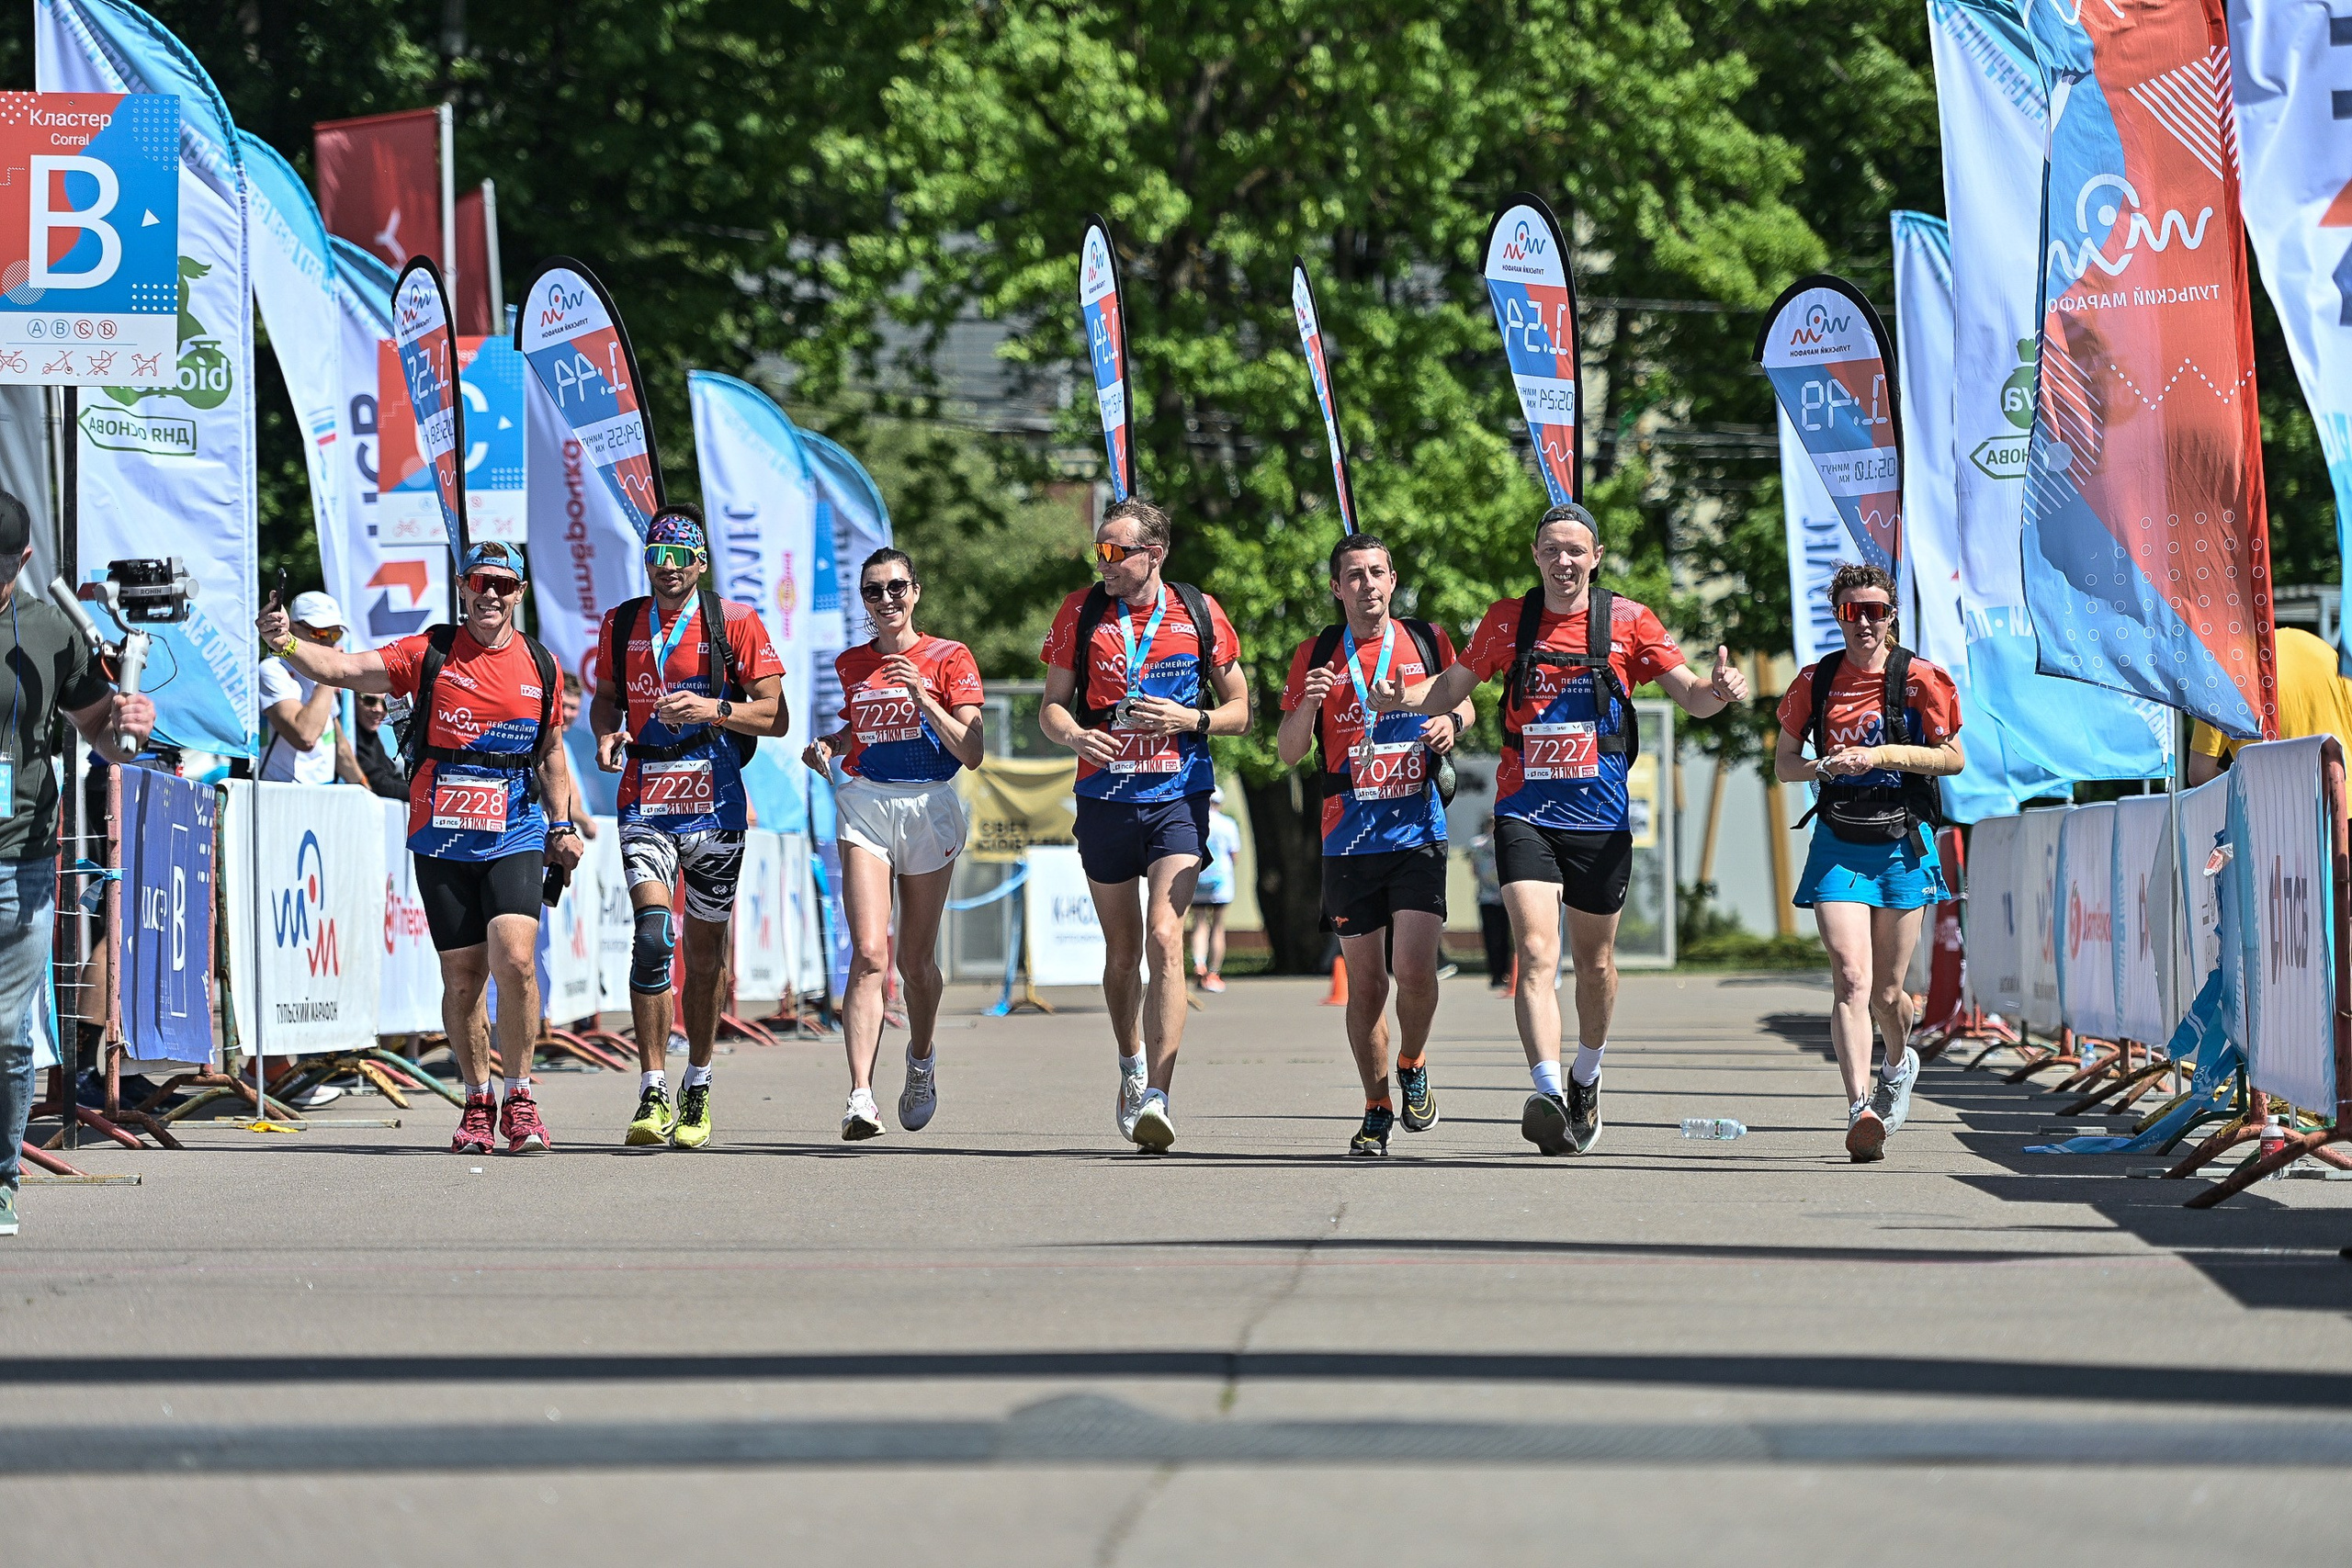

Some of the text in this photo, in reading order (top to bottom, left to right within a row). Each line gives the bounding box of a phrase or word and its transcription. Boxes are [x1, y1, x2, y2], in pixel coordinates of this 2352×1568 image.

[28, 108, 112, 130] Кластер
[50, 133, 90, 146] Corral
[28, 153, 122, 289] B
[30, 322, 42, 334] A
[55, 322, 66, 334] B
[139, 587, 163, 596] RONIN
[667, 681, 710, 690] ПЕЙСМЕЙК
[1561, 675, 1593, 685] ПЕЙСМЕ
[486, 719, 535, 733] ПЕЙСМЕЙКЕР
[855, 702, 916, 728] 7229
[483, 728, 532, 741] pacemaker
[1120, 734, 1171, 756] 7112
[1530, 739, 1595, 763] 7227
[1353, 756, 1421, 784] 7048
[646, 776, 710, 800] 7226
[439, 790, 503, 817] 7228
[2283, 875, 2309, 969] ПСБ
[276, 997, 338, 1024] ТУЛЬСКИЙ МАРАФОН
